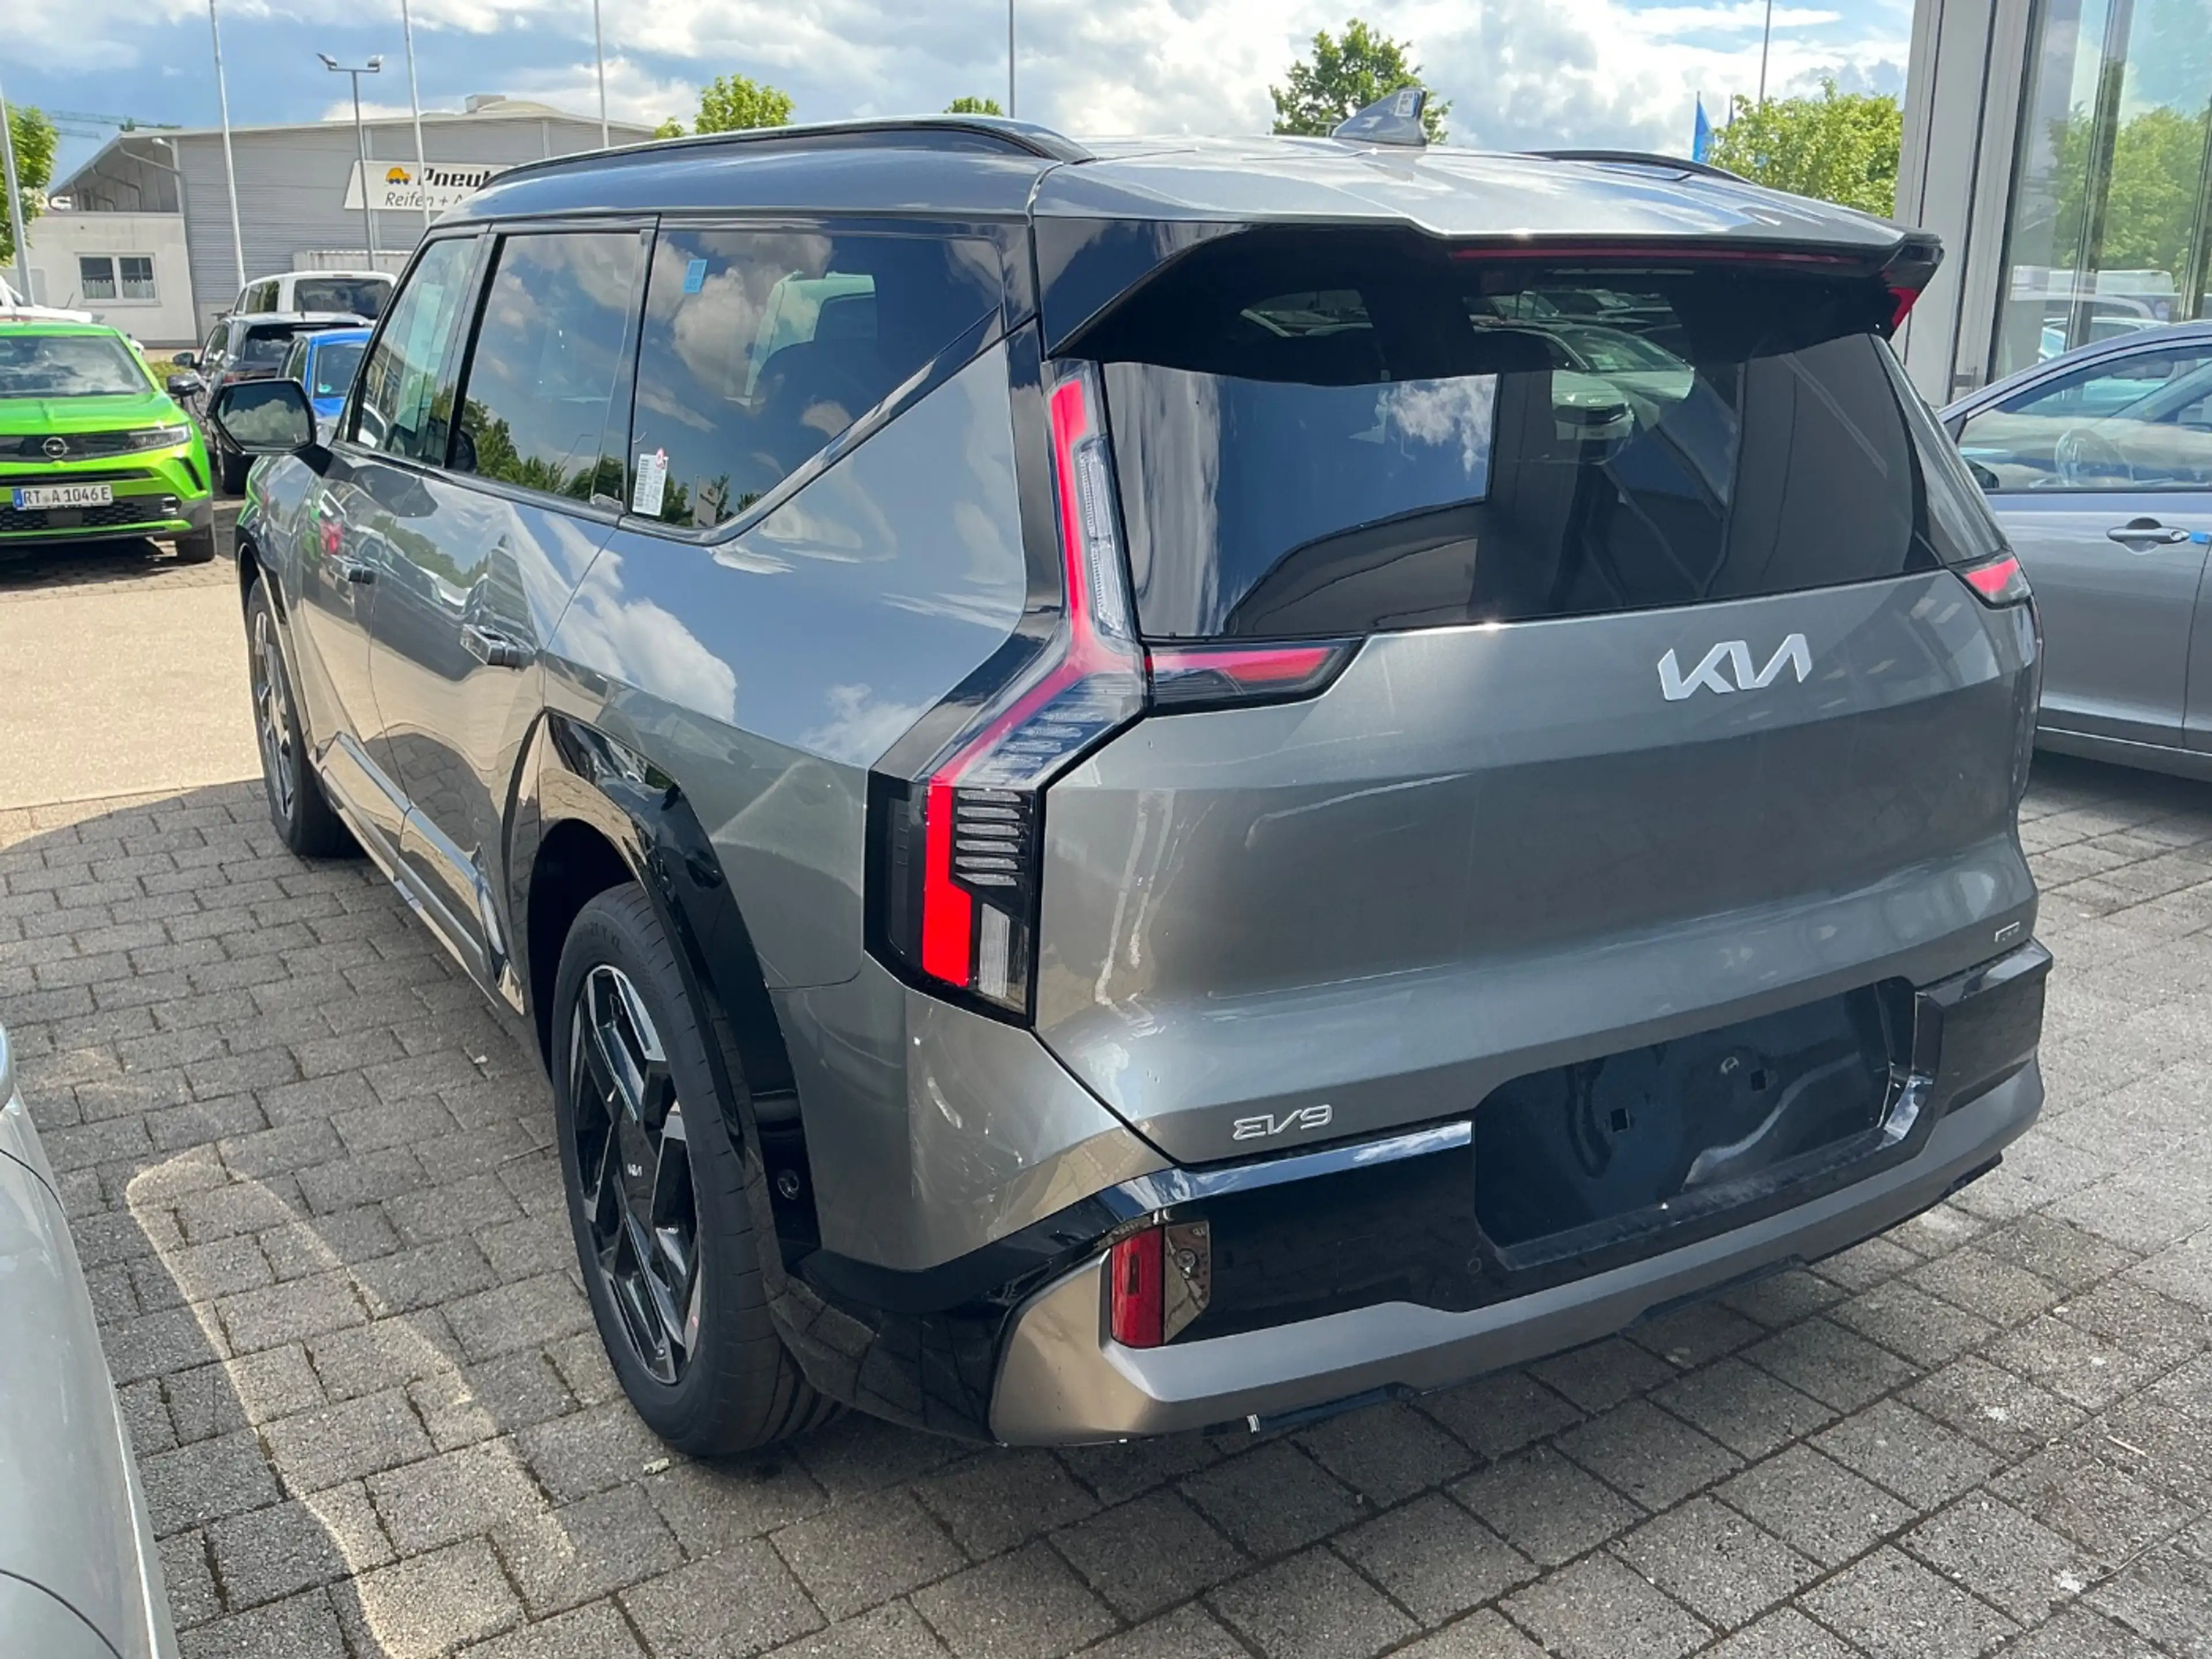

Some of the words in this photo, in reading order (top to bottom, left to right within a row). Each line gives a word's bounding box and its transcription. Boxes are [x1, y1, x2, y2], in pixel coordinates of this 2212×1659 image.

[385, 191, 434, 207] Reifen
[24, 490, 40, 505] RT
[52, 490, 60, 503] A
[1657, 633, 1812, 701] KIA
[1232, 1104, 1333, 1141] EV9
